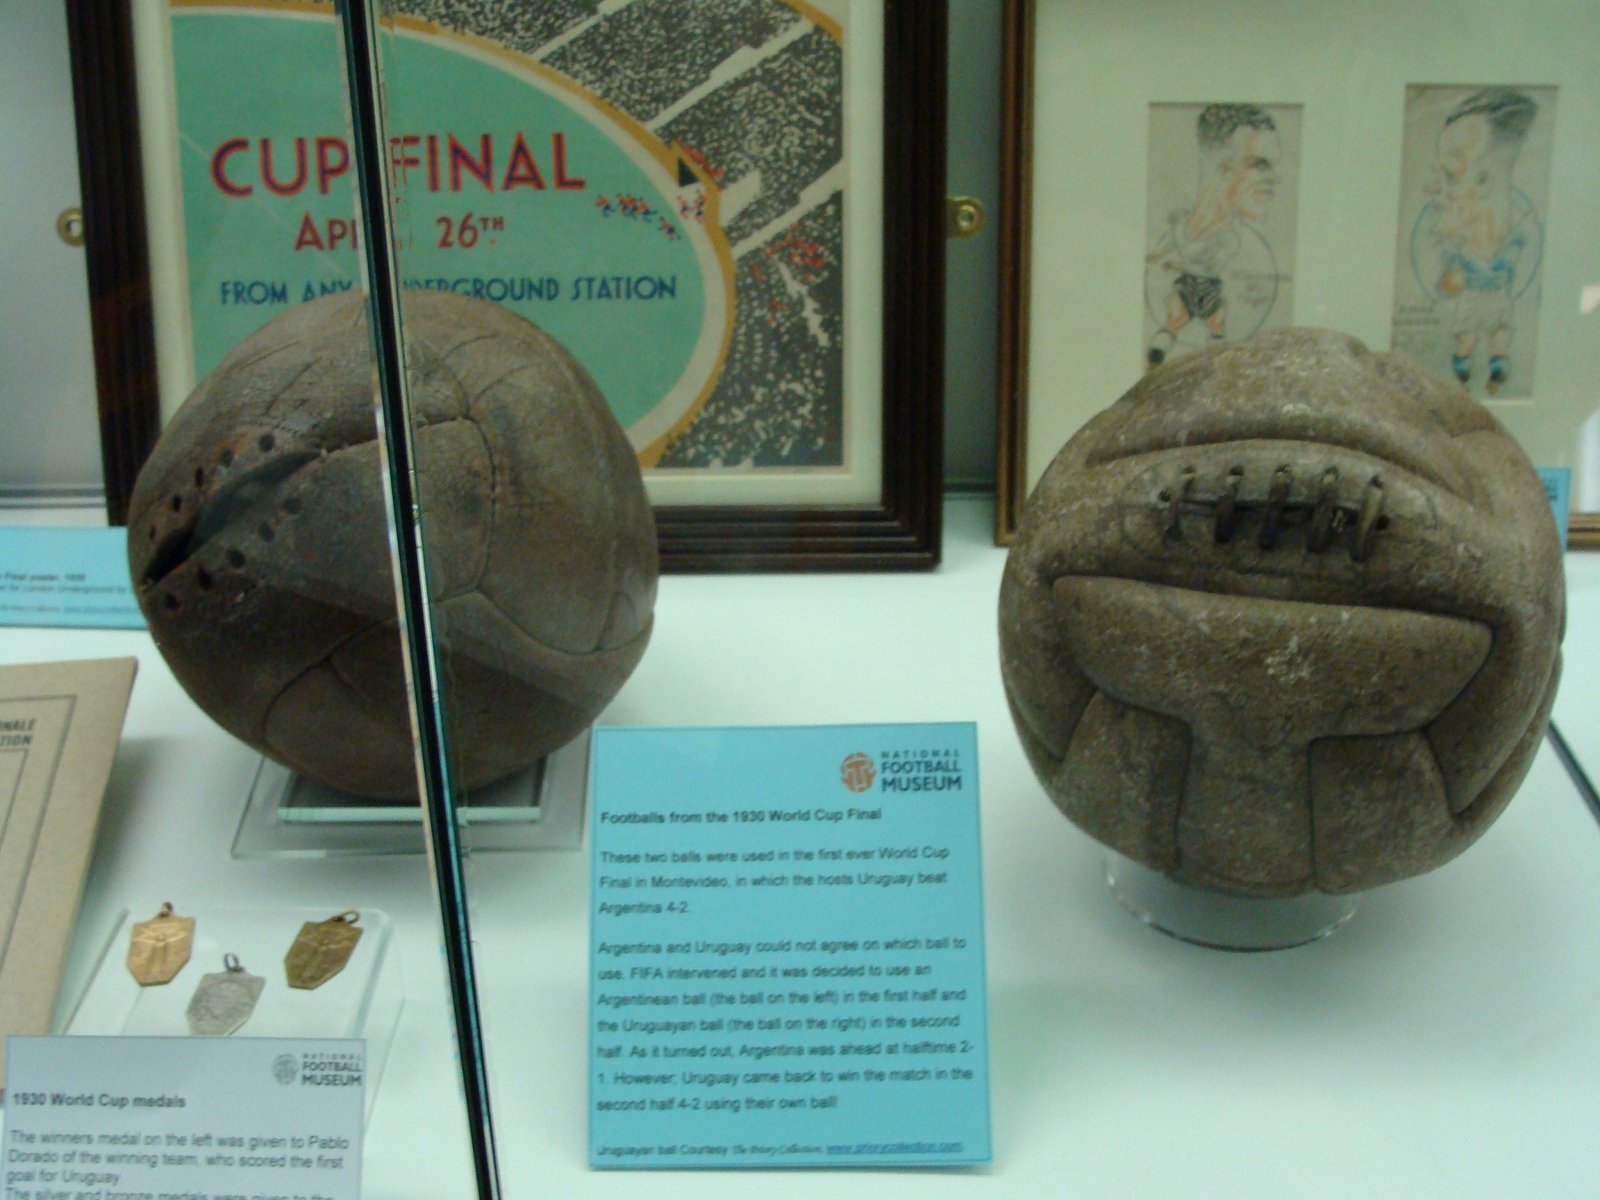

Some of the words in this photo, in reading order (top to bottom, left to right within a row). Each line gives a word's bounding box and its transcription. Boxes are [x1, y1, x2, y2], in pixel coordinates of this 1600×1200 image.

[210, 135, 350, 198] CUP
[390, 134, 586, 193] FINAL
[221, 281, 288, 304] FROM
[571, 276, 676, 300] STATION
[881, 750, 960, 758] NATIONAL
[881, 760, 961, 774] FOOTBALL
[881, 776, 962, 792] MUSEUM
[600, 812, 665, 824] Footballs
[670, 811, 701, 822] from
[707, 811, 728, 822] the
[733, 811, 764, 822] 1930
[770, 810, 810, 821] World
[816, 810, 842, 823] Cup
[848, 808, 881, 820] Final
[600, 851, 640, 863] These
[646, 852, 667, 862] two
[672, 851, 701, 862] balls
[707, 853, 737, 862] were
[743, 850, 774, 861] used
[779, 850, 789, 860] in
[794, 849, 814, 860] the
[818, 848, 842, 860] first
[846, 850, 875, 859] ever
[879, 847, 917, 858] World
[923, 847, 949, 861] Cup
[600, 876, 631, 888] Final
[636, 876, 646, 887] in
[736, 874, 747, 886] in
[752, 874, 789, 886] which
[793, 874, 813, 885] the
[818, 873, 853, 885] hosts
[858, 873, 913, 887] Uruguay
[918, 872, 946, 884] beat
[599, 902, 661, 917] Argentina
[599, 942, 661, 956] Argentina
[666, 942, 690, 953] and
[695, 941, 751, 955] Uruguay
[757, 940, 791, 952] could
[795, 941, 816, 951] not
[821, 942, 858, 955] agree
[863, 941, 880, 950] on
[885, 938, 922, 950] which
[926, 938, 949, 950] ball
[953, 938, 966, 949] to
[630, 968, 662, 979] FIFA
[667, 967, 736, 979] intervened
[741, 967, 765, 978] and
[770, 966, 778, 977] it
[782, 968, 807, 977] was
[812, 965, 864, 977] decided
[869, 965, 881, 976] to
[886, 967, 909, 976] use
[914, 966, 932, 975] an
[597, 993, 678, 1008] Argentinean
[683, 992, 706, 1005] ball
[740, 992, 762, 1003] ball
[767, 993, 784, 1003] on
[789, 991, 808, 1003] the
[844, 990, 854, 1002] in
[859, 990, 879, 1001] the
[884, 989, 908, 1001] first
[913, 988, 936, 1001] half
[941, 988, 966, 1000] and
[598, 1020, 618, 1032] the
[623, 1020, 695, 1034] Uruguayan
[700, 1019, 723, 1031] ball
[757, 1018, 780, 1030] ball
[785, 1020, 802, 1030] on
[806, 1018, 827, 1030] the
[871, 1016, 881, 1028] in
[886, 1016, 906, 1028] the
[911, 1015, 960, 1028] second
[629, 1046, 647, 1058] As
[652, 1046, 659, 1057] it
[663, 1045, 706, 1057] turned
[738, 1044, 804, 1059] Argentina
[808, 1045, 835, 1055] was
[840, 1043, 881, 1055] ahead
[886, 1043, 899, 1054] at
[903, 1041, 955, 1054] halftime
[302, 1062, 361, 1072] FOOTBALL
[302, 1074, 362, 1086] MUSEUM
[682, 1071, 738, 1087] Uruguay
[743, 1072, 779, 1083] came
[784, 1070, 816, 1082] back
[820, 1071, 833, 1082] to
[838, 1070, 860, 1081] win
[864, 1069, 885, 1081] the
[890, 1068, 931, 1081] match
[936, 1068, 947, 1080] in
[951, 1068, 972, 1080] the
[13, 1094, 46, 1106] 1930
[51, 1094, 94, 1106] World
[100, 1094, 128, 1108] Cup
[133, 1095, 186, 1107] medals
[598, 1098, 646, 1111] second
[650, 1097, 674, 1110] half
[678, 1097, 700, 1109] 4-2
[705, 1097, 741, 1112] using
[745, 1097, 774, 1109] their
[779, 1098, 806, 1108] own
[11, 1130, 35, 1144] The
[40, 1132, 93, 1144] winners
[98, 1132, 140, 1145] medal
[144, 1135, 161, 1145] on
[165, 1133, 187, 1145] the
[191, 1134, 213, 1146] left
[217, 1137, 244, 1148] was
[249, 1136, 286, 1150] given
[291, 1136, 304, 1148] to
[309, 1136, 348, 1149] Pablo
[10, 1151, 58, 1163] Dorado
[63, 1151, 77, 1163] of
[81, 1152, 102, 1164] the
[106, 1152, 157, 1167] winning
[205, 1154, 234, 1166] who
[239, 1154, 286, 1167] scored
[291, 1155, 312, 1168] the
[317, 1155, 343, 1168] first
[7, 1170, 35, 1184] goal
[39, 1170, 58, 1182] for
[62, 1170, 119, 1186] Uruguay
